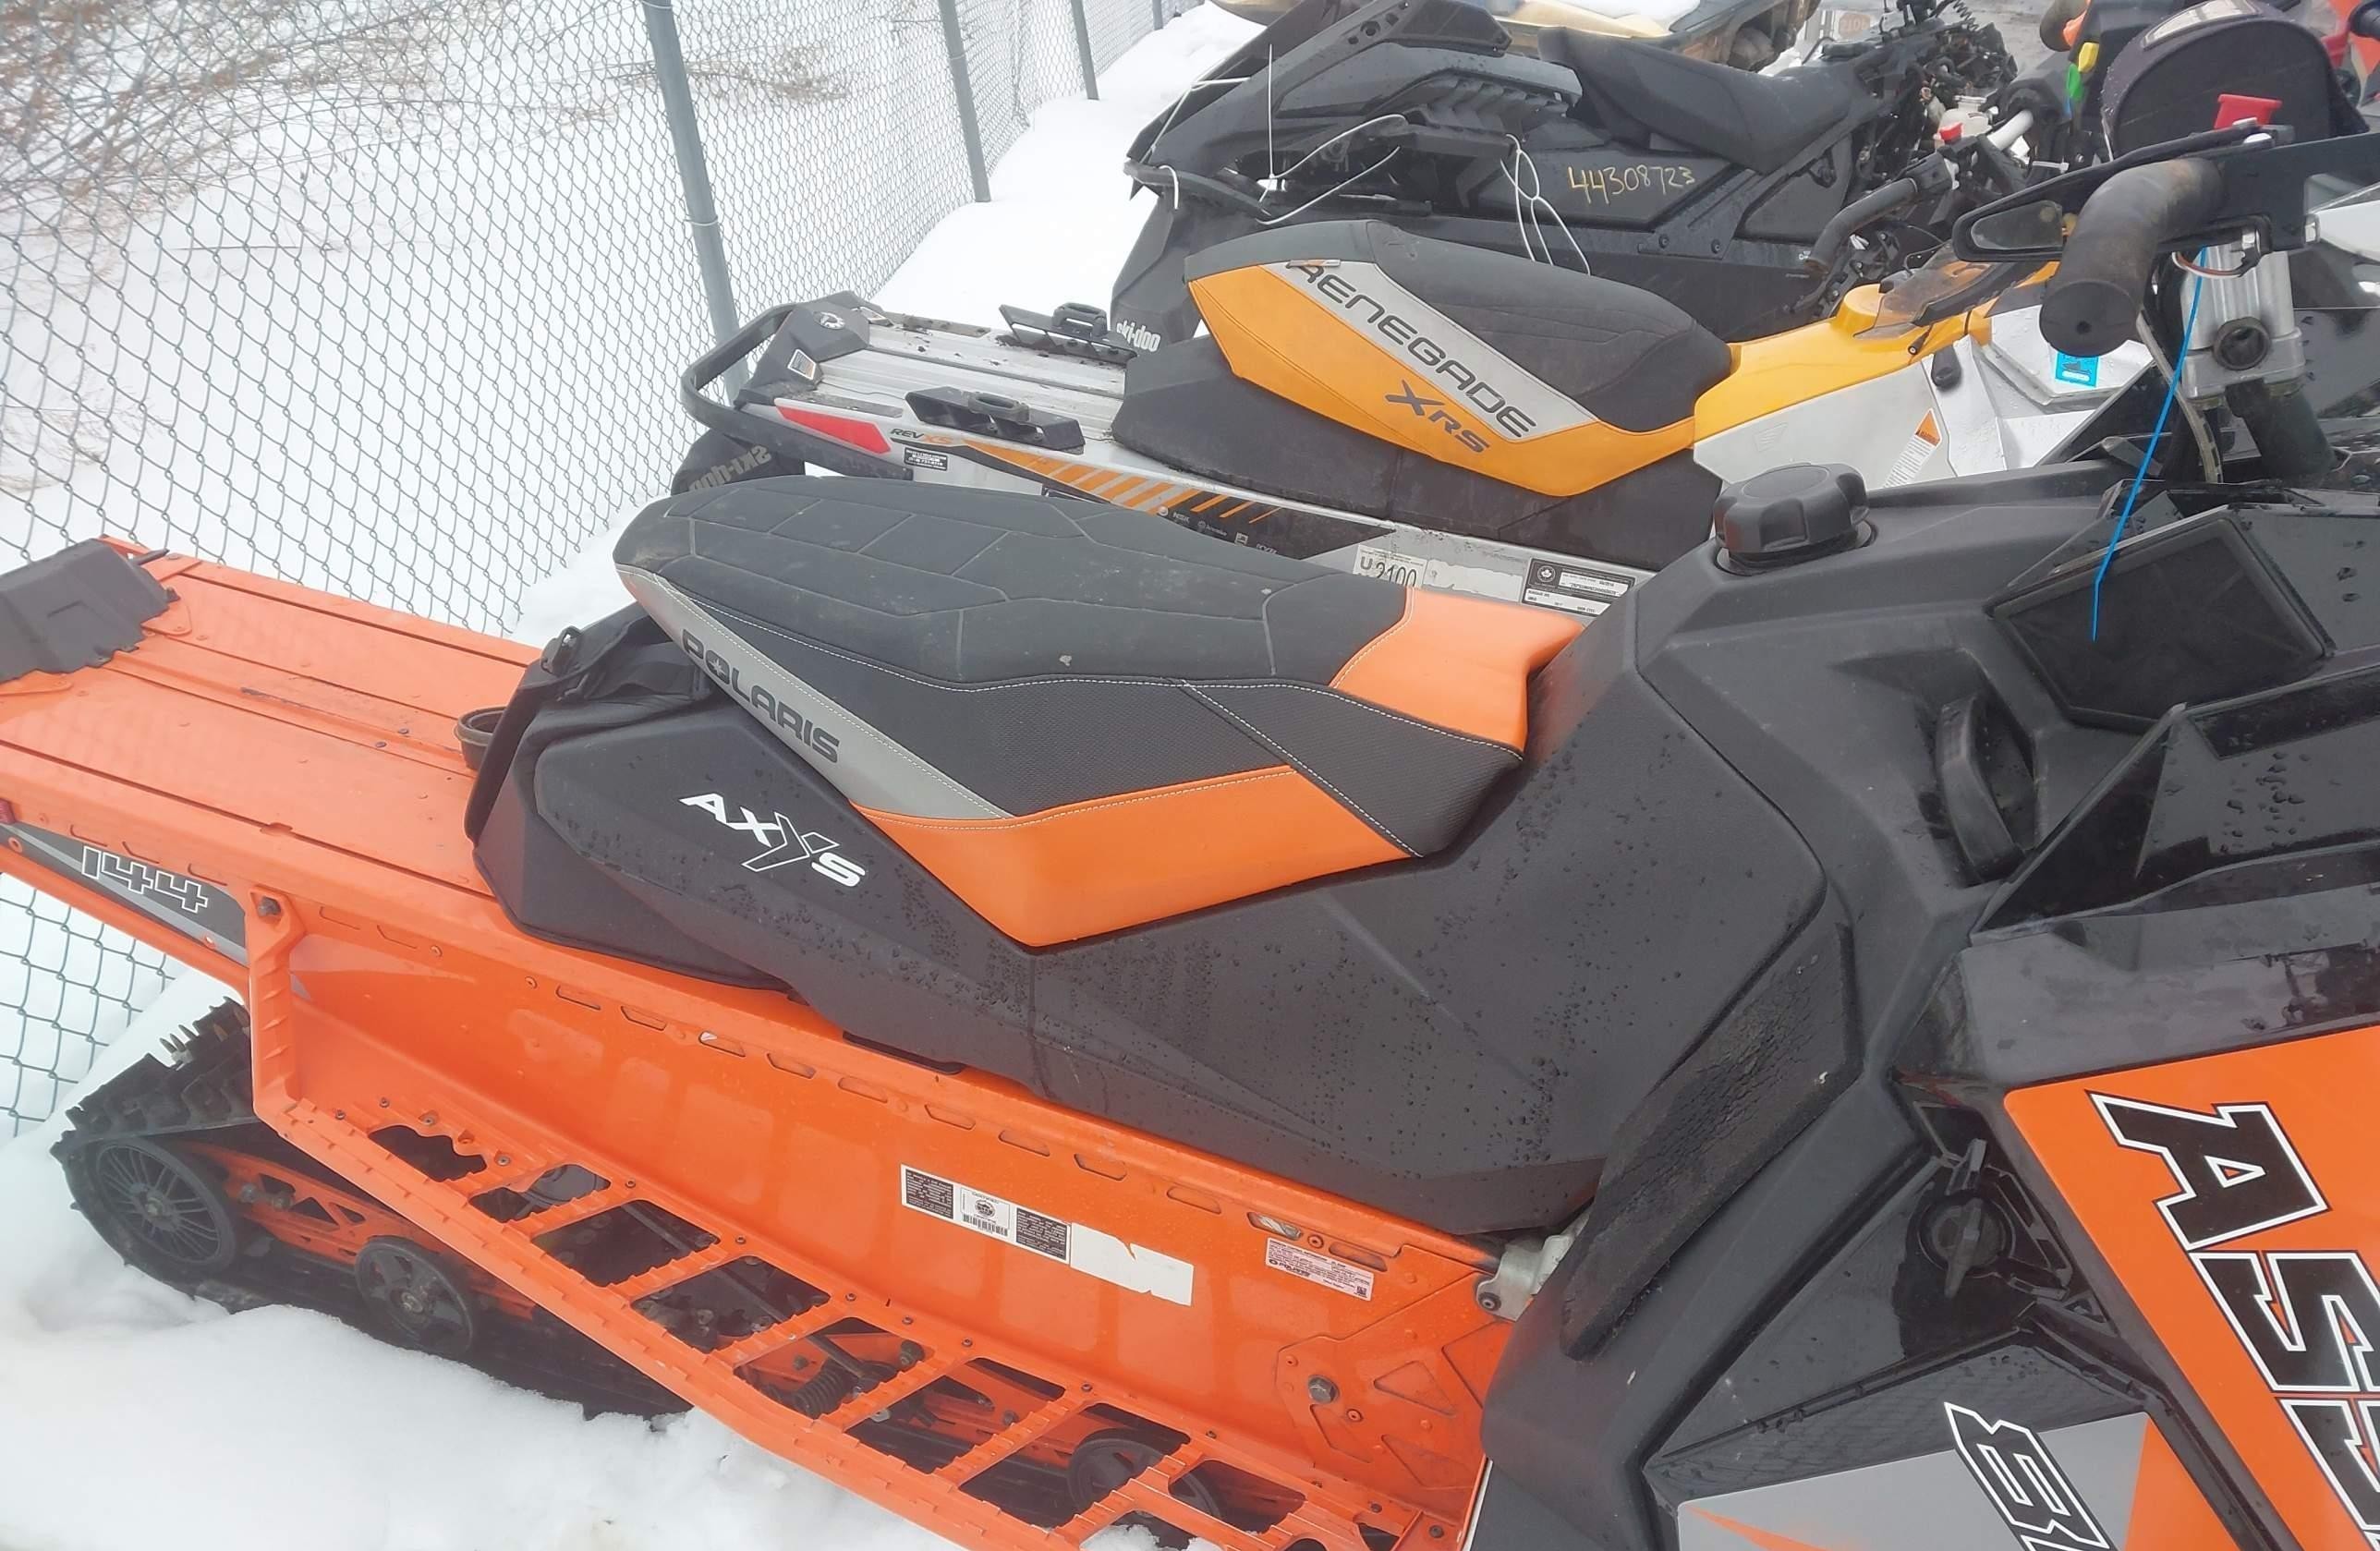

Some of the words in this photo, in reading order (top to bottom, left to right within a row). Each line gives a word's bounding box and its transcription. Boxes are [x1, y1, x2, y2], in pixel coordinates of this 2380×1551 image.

[1568, 164, 1695, 204] 44308723
[682, 628, 841, 764] POLARIS
[81, 845, 209, 914] 144
[2084, 1089, 2380, 1551] ASS
[1944, 1400, 2112, 1551] 8
